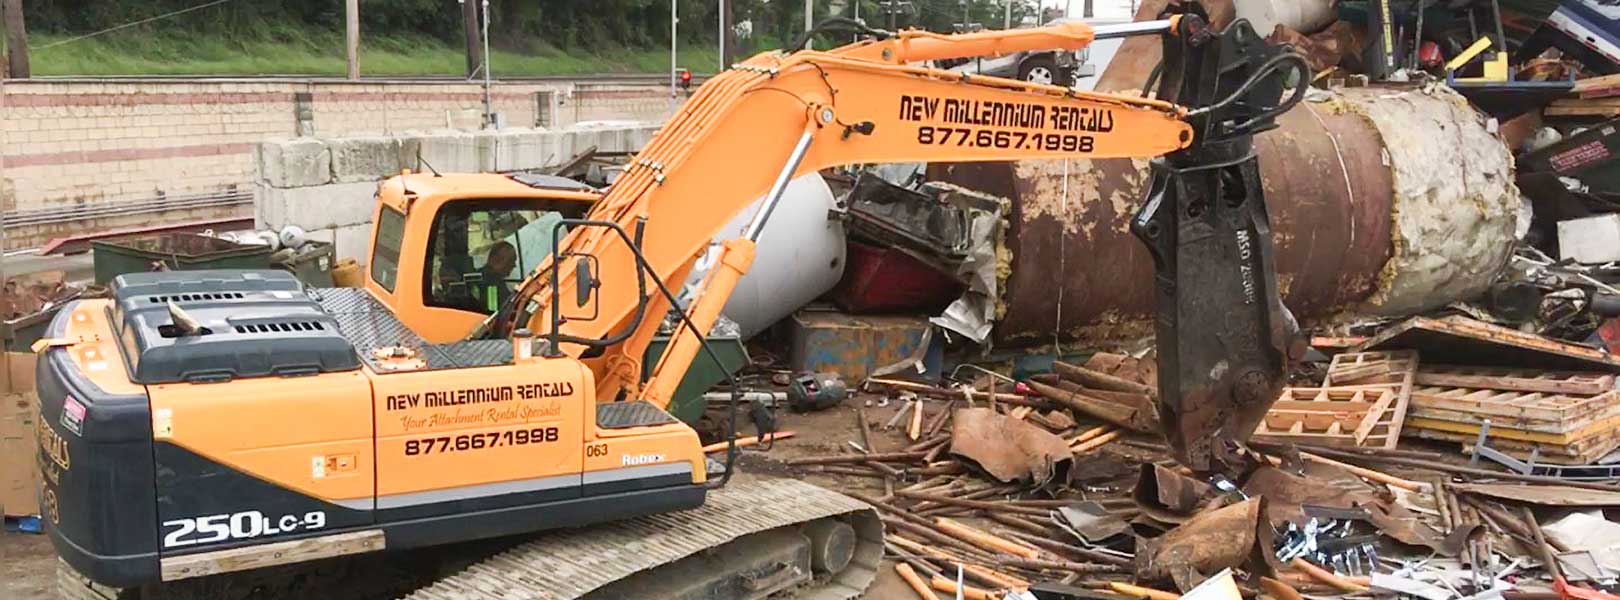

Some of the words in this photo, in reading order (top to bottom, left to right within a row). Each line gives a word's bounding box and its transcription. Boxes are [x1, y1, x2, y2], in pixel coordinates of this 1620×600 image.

[899, 95, 940, 121] NEW
[943, 98, 1046, 129] MILLENNIUM
[1050, 106, 1114, 133] RENTALS
[917, 126, 1095, 152] 877.667.1998
[387, 394, 421, 411] NEW
[424, 386, 513, 408] MILLENNIUM
[517, 381, 574, 400] RENTALS
[400, 414, 426, 432] Your
[428, 407, 484, 428] Attachment
[486, 402, 518, 423] Rental
[520, 401, 561, 424] Specialist
[404, 427, 559, 456] 877.667.1998
[586, 443, 609, 457] 063
[621, 453, 666, 467] Robex
[162, 510, 326, 548] 250LC-9
